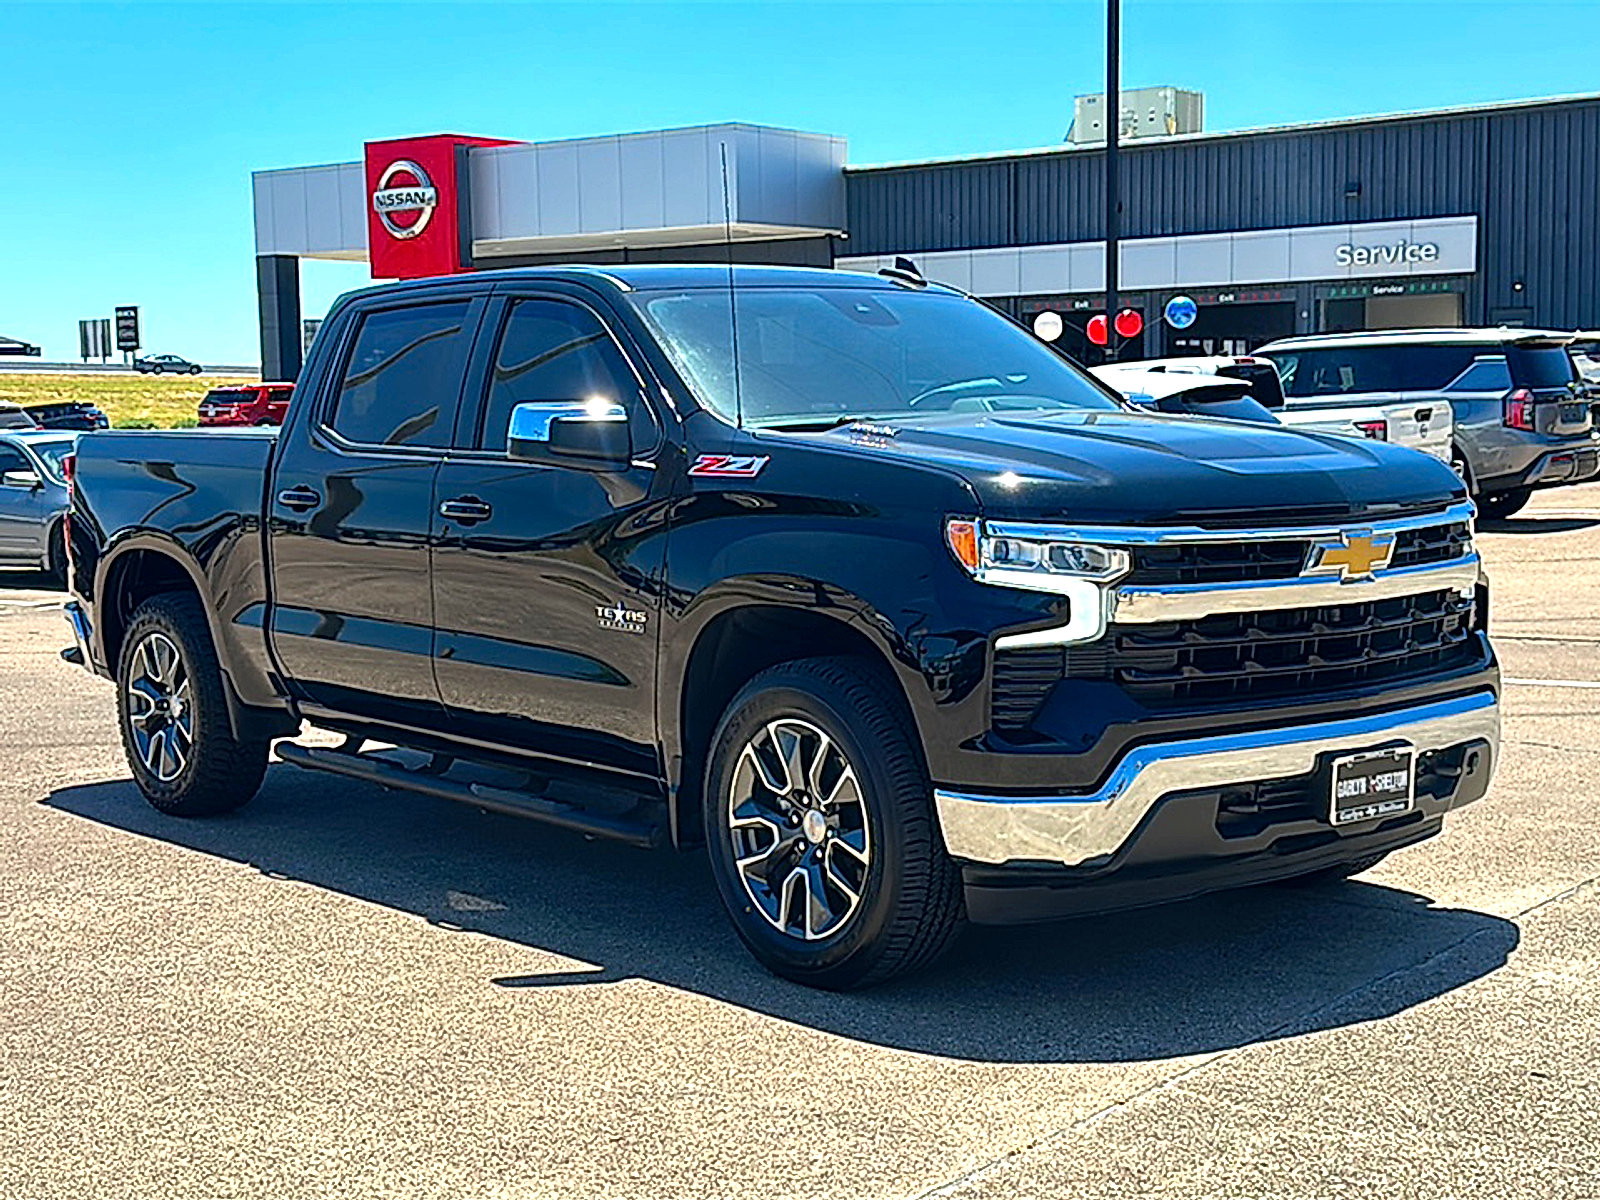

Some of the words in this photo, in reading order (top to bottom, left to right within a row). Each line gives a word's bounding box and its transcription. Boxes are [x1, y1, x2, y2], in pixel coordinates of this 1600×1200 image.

[375, 191, 426, 206] NISSAN
[1336, 239, 1438, 267] Service
[1372, 285, 1405, 295] Service
[688, 454, 770, 477] Z71
[595, 602, 647, 623] TEXAS
